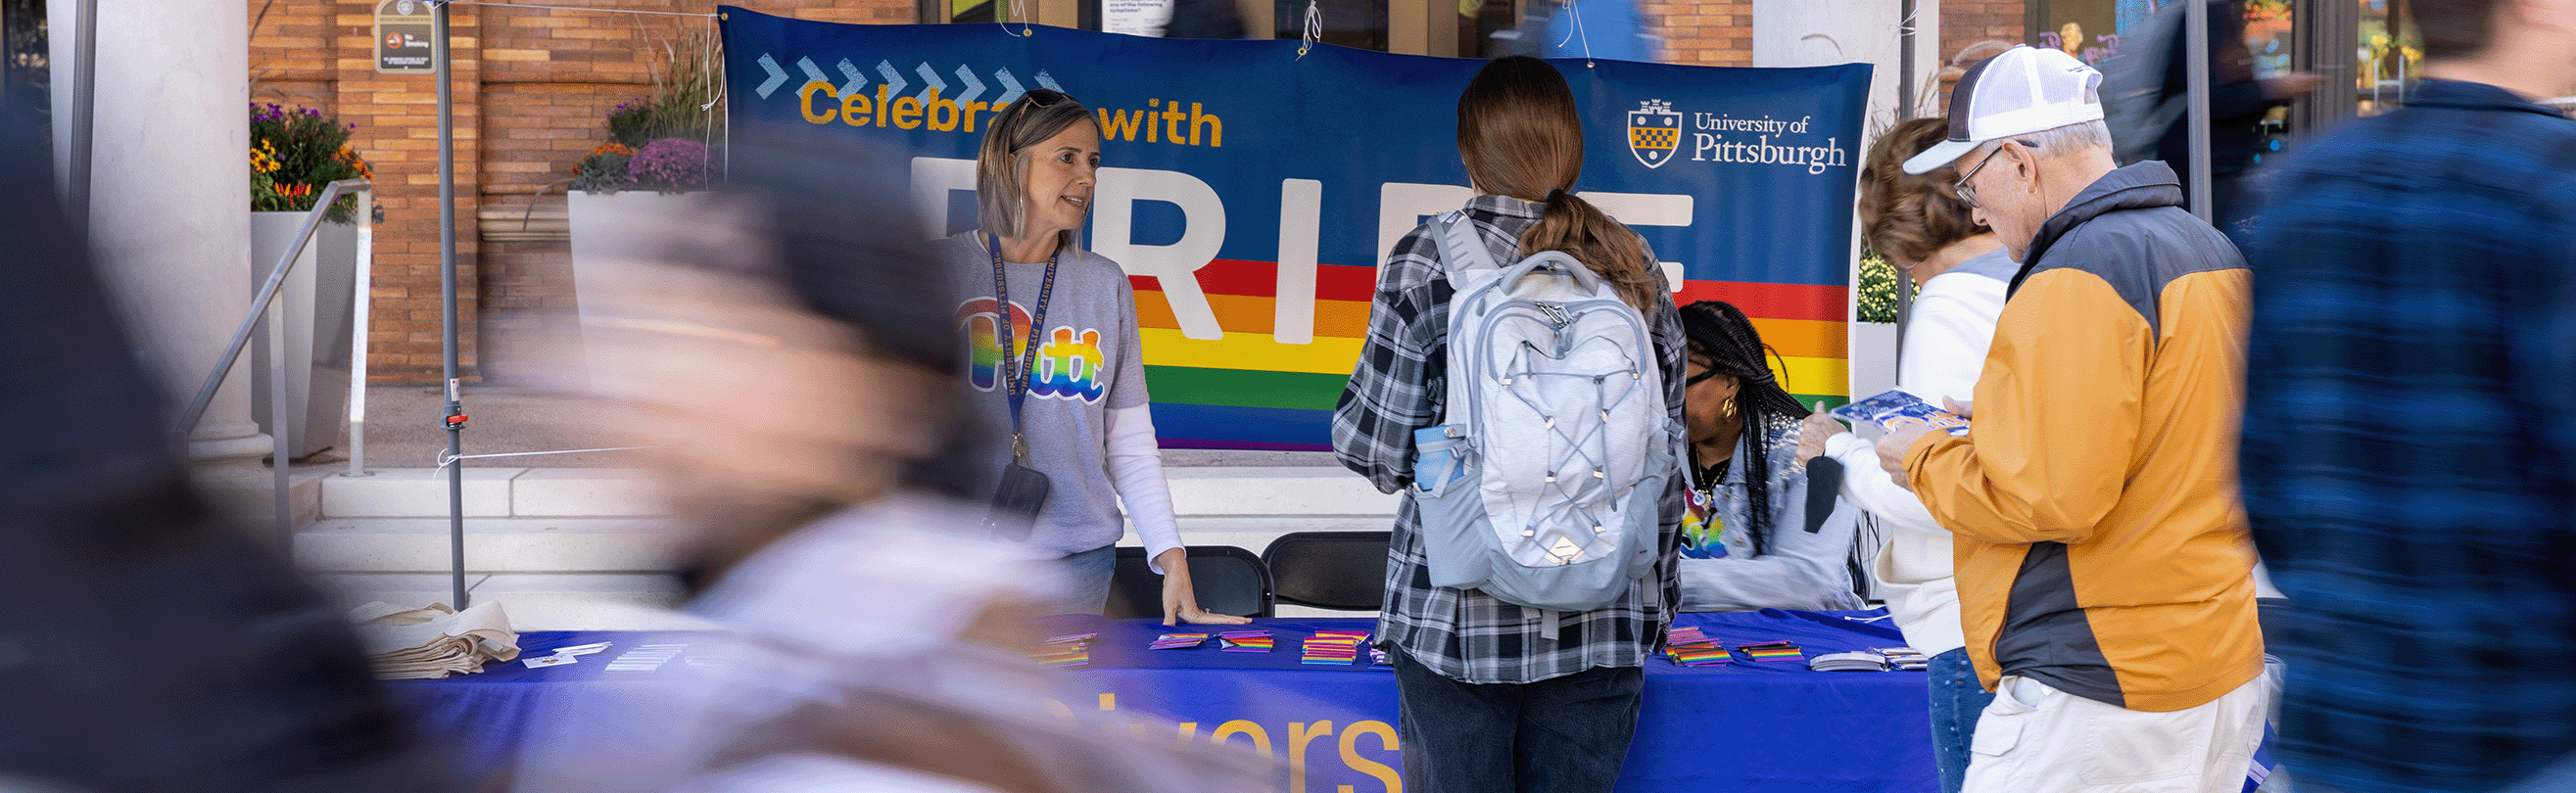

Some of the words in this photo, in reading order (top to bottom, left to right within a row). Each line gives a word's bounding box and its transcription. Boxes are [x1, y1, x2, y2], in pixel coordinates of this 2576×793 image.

[800, 80, 1010, 132] Celebr
[1098, 99, 1222, 147] with
[1694, 112, 1788, 138] University
[1789, 116, 1810, 133] of
[1692, 133, 1846, 174] Pittsburgh
[1039, 257, 1056, 310] UNIVERSITY
[1002, 318, 1011, 331] OF
[1034, 312, 1044, 325] OF
[1004, 334, 1016, 396] UNIVERSITY
